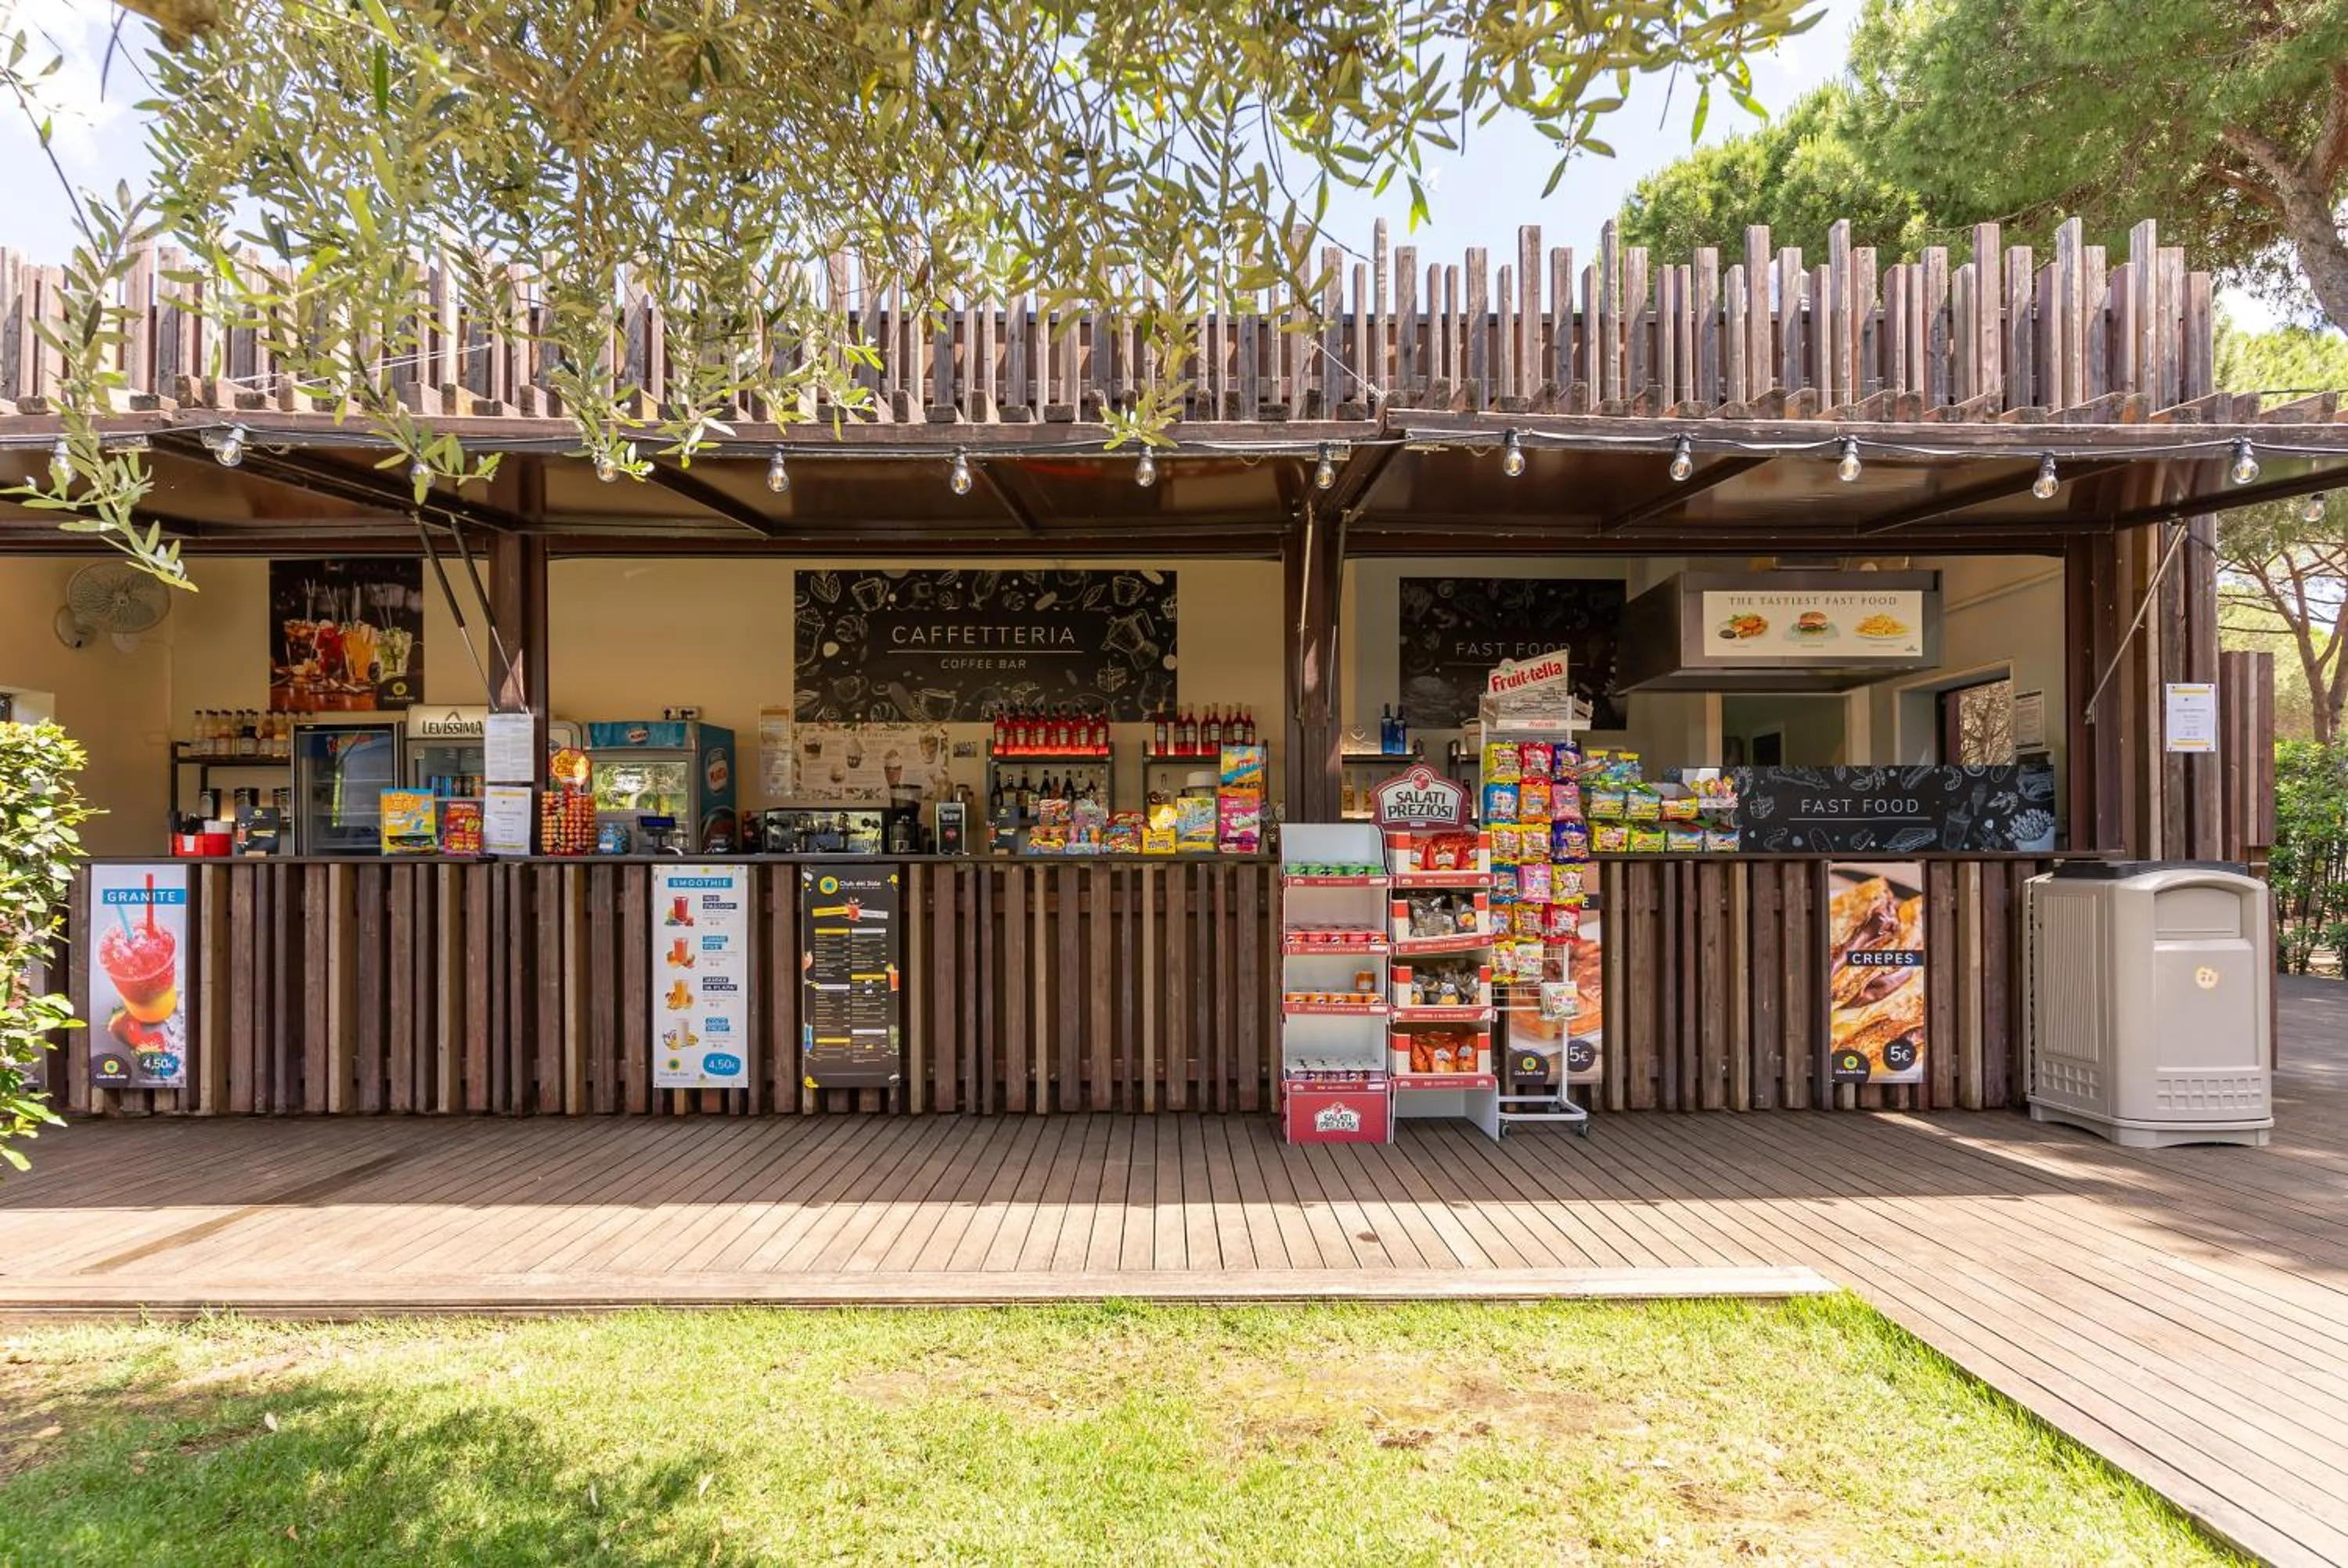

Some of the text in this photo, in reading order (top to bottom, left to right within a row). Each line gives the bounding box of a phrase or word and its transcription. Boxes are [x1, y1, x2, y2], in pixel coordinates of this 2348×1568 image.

[1729, 596, 1898, 606] THE TASTIEST FAST FOOD
[891, 626, 1075, 644] CAFFETTERIA
[1456, 642, 1506, 656] FAST
[941, 659, 1027, 669] COFFEE BAR
[423, 720, 483, 735] LEVISSIMA
[1395, 791, 1446, 804] SALATI
[1388, 804, 1453, 818] PREZIOSI
[1801, 799, 1919, 813] FAST FOOD
[673, 879, 728, 887] SMOOTHIE
[107, 890, 176, 903] GRANITE
[1852, 952, 1914, 965] CREPES
[1569, 1046, 1589, 1063] 5€
[1889, 1045, 1910, 1062] 5€
